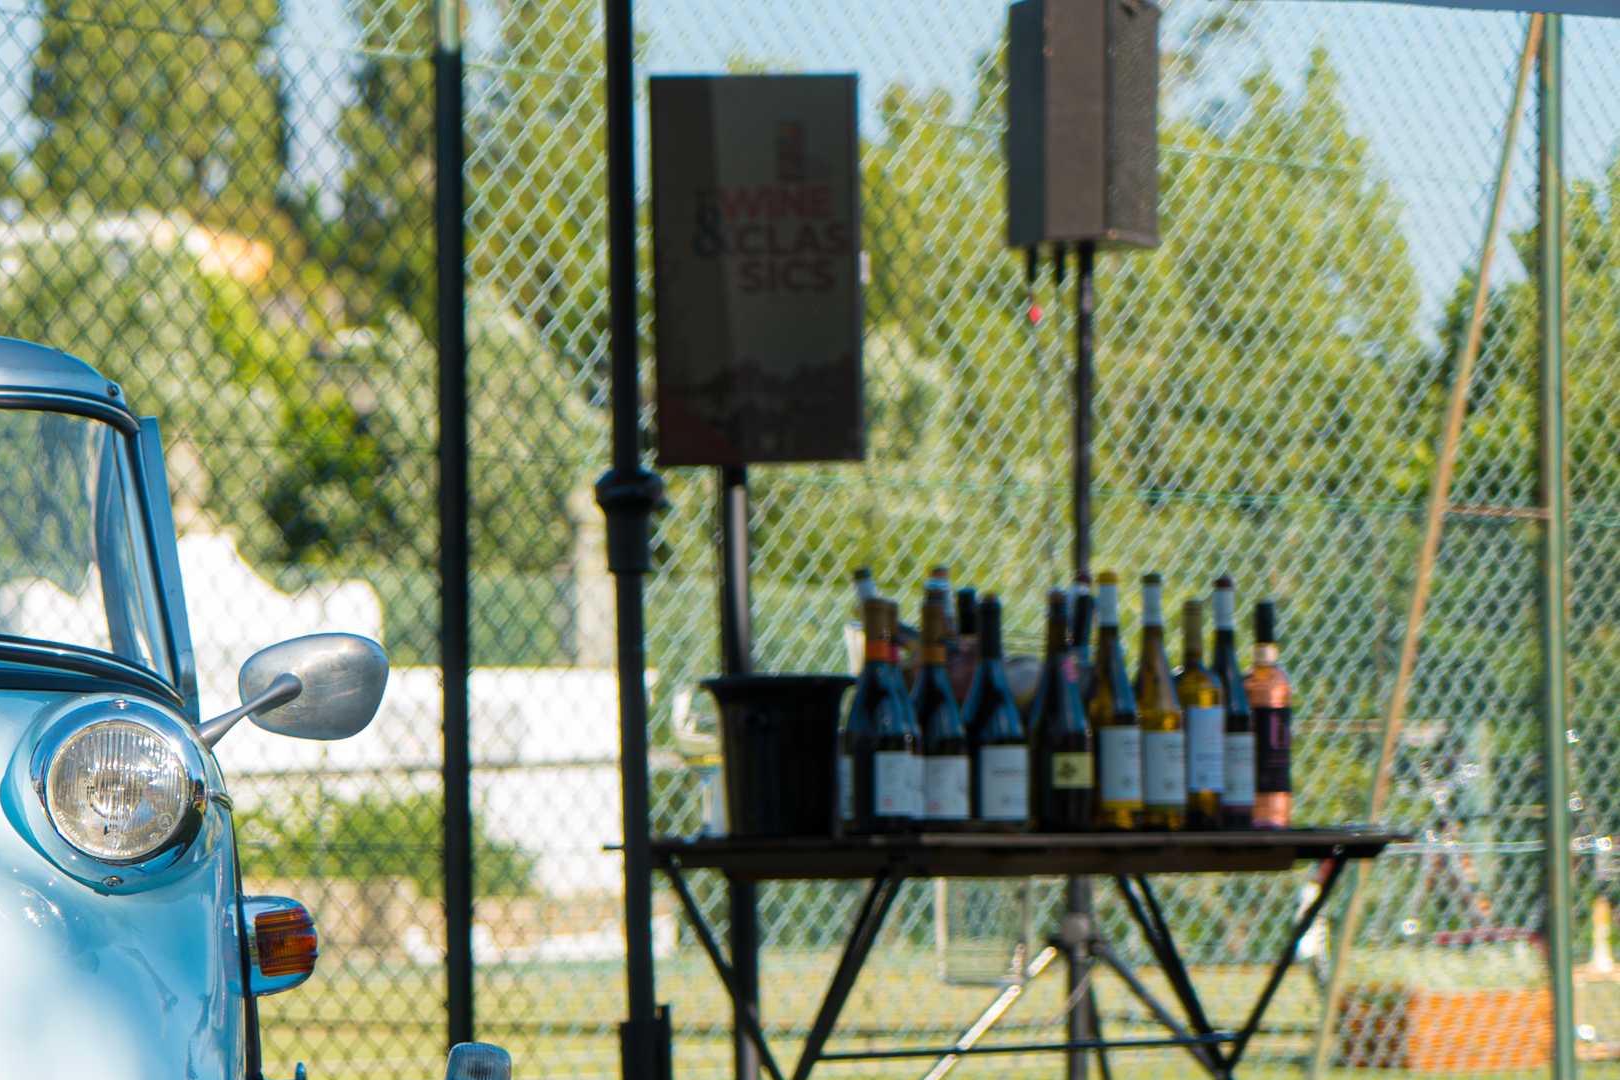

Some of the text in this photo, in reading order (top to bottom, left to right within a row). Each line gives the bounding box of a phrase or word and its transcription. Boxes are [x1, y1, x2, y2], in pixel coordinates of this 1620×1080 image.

[717, 185, 833, 220] WINE
[736, 223, 848, 257] CLAS
[739, 259, 836, 293] SICS
